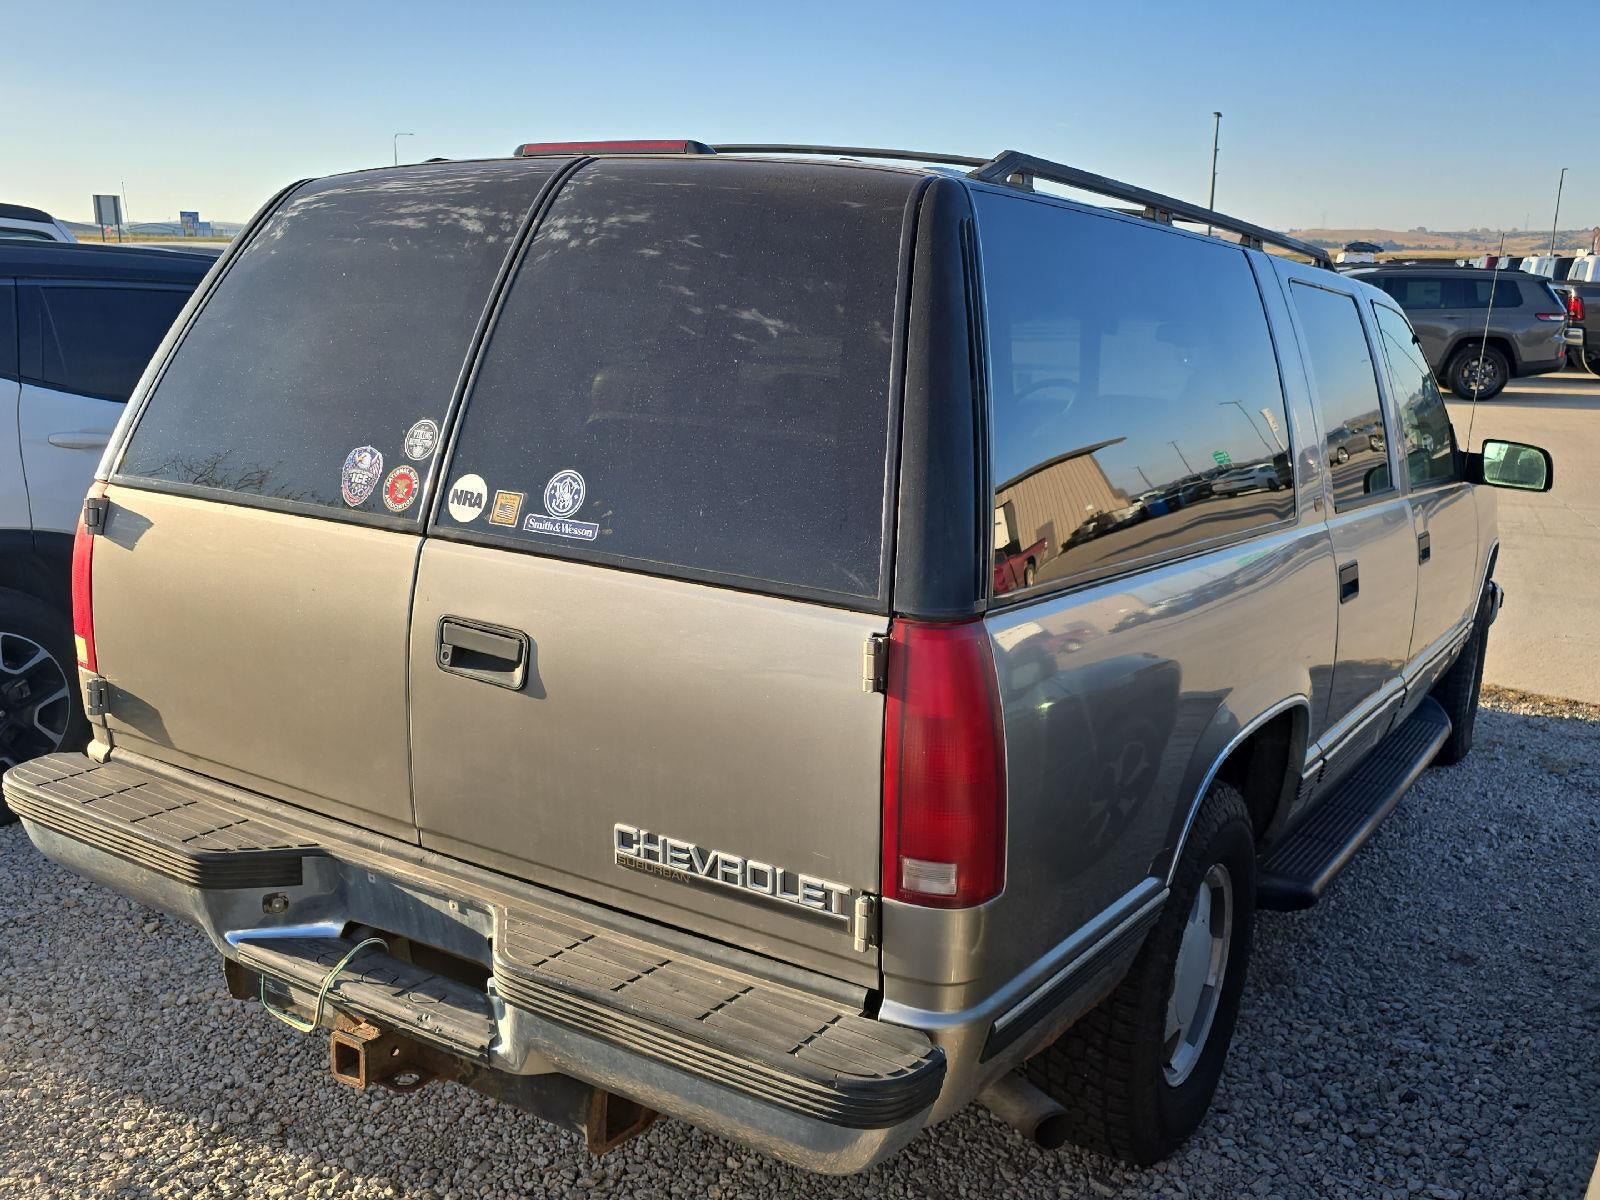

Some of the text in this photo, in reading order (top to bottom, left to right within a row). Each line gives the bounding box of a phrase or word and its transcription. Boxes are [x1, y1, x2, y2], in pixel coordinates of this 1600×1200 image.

[351, 473, 369, 485] ICE
[450, 488, 483, 509] NRA
[613, 823, 853, 915] CHEVROLET
[616, 855, 691, 884] SUBURBAN
